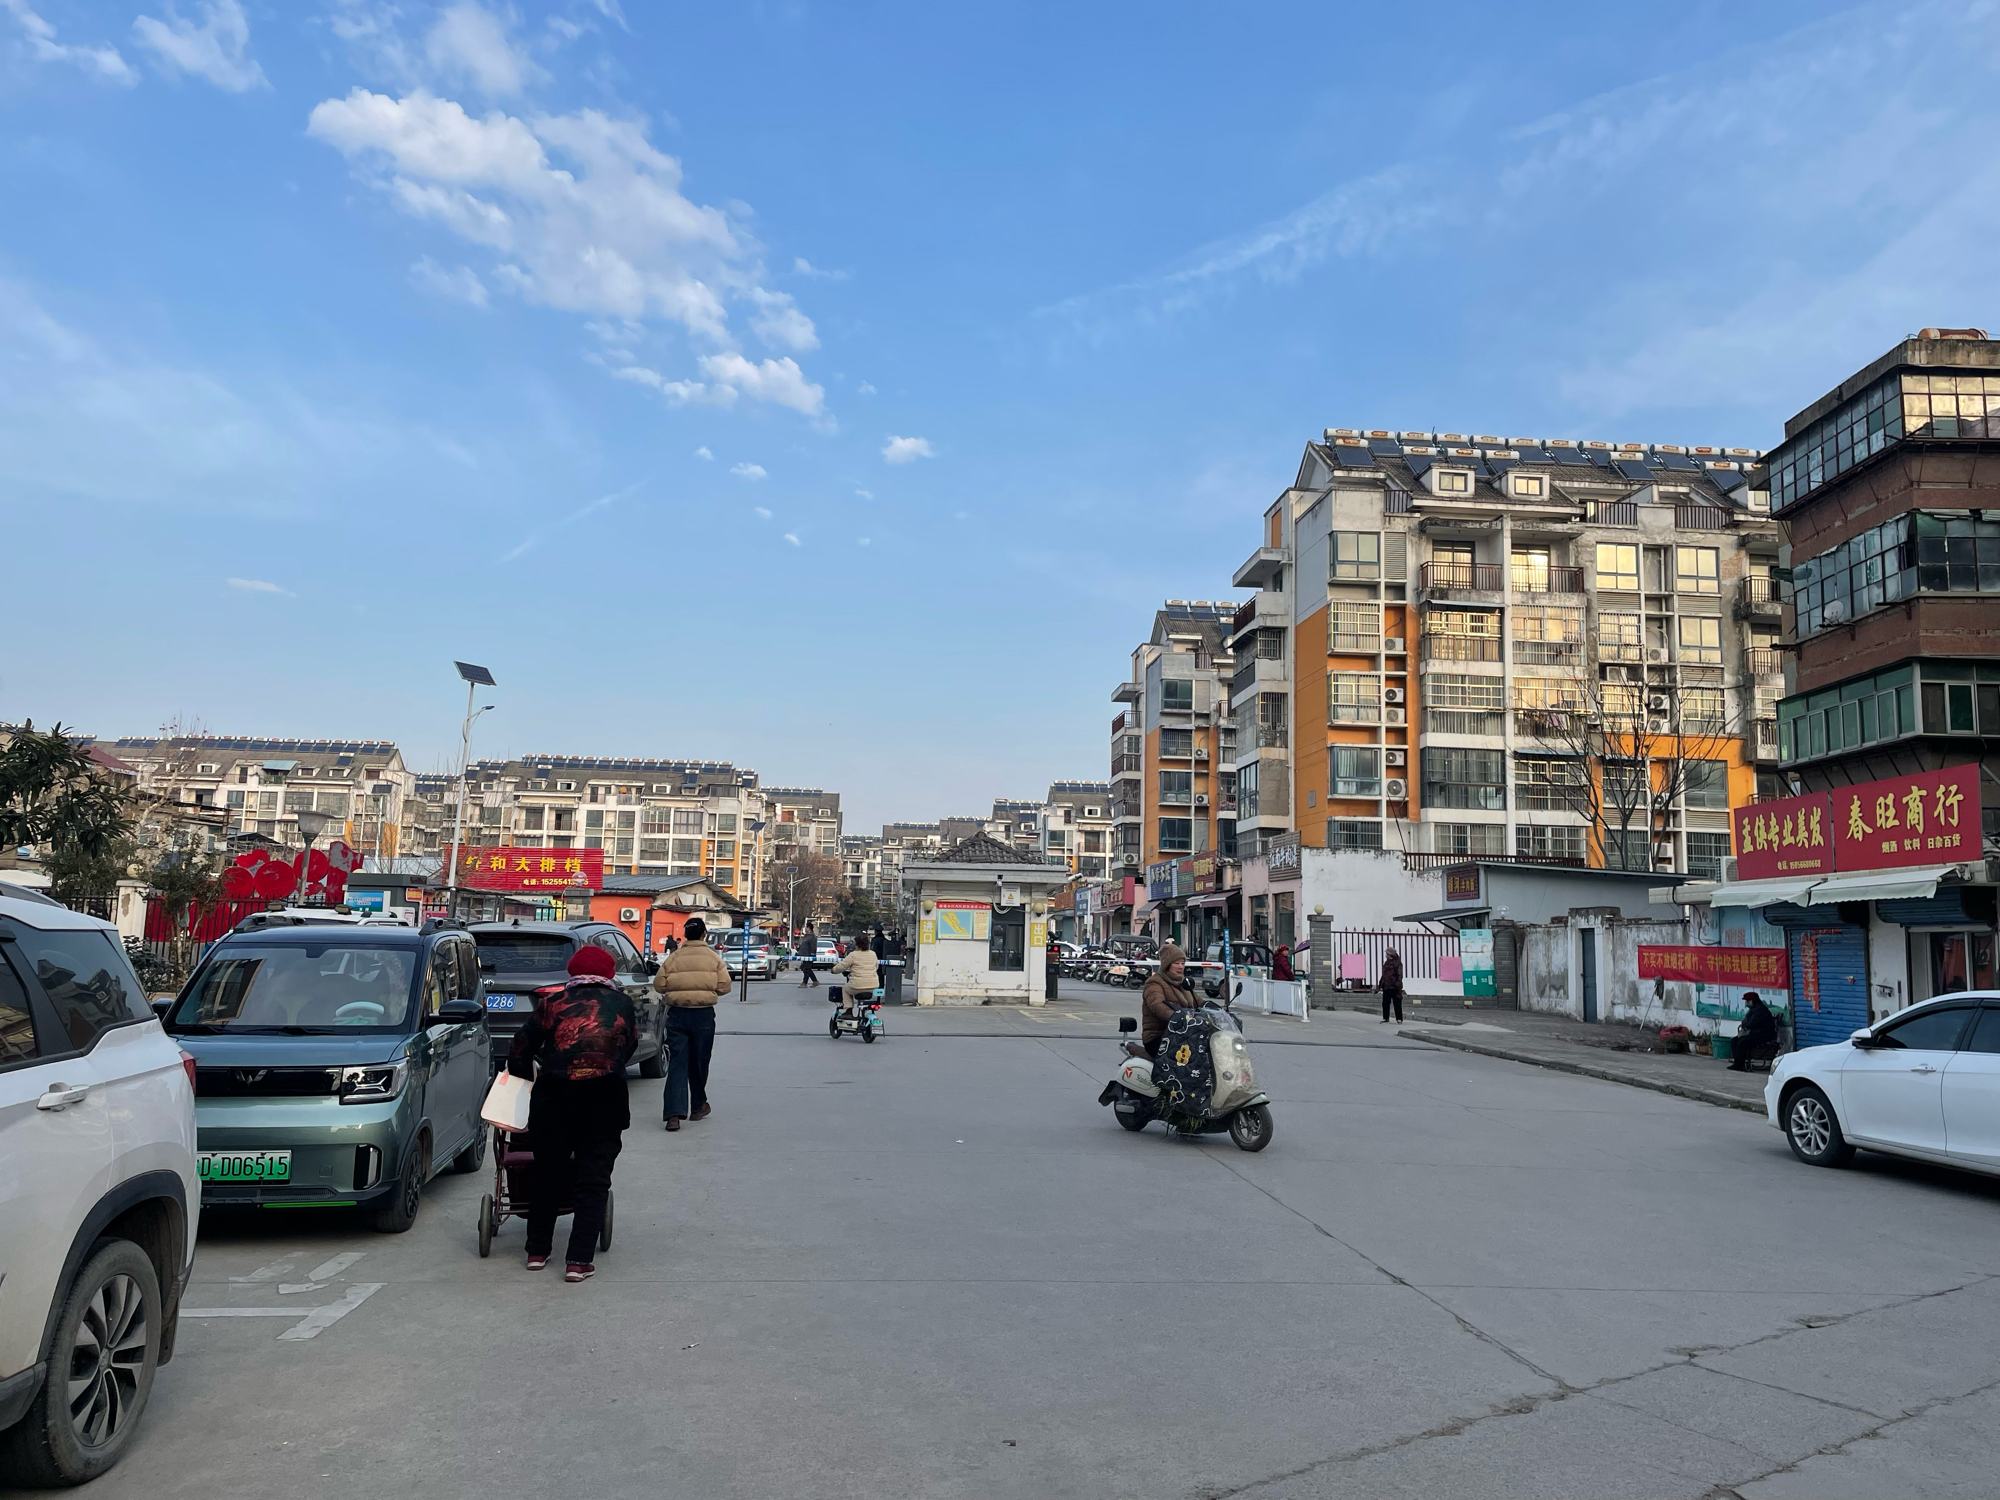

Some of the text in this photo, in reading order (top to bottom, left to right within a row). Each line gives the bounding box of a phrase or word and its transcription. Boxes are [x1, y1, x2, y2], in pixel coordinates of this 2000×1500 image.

[1846, 784, 1964, 841] 春旺商行
[1882, 833, 1961, 854] 烟酒 饮料 日杂百货
[923, 921, 934, 943] 进口
[1033, 923, 1044, 946] 出口
[486, 996, 514, 1008] C286
